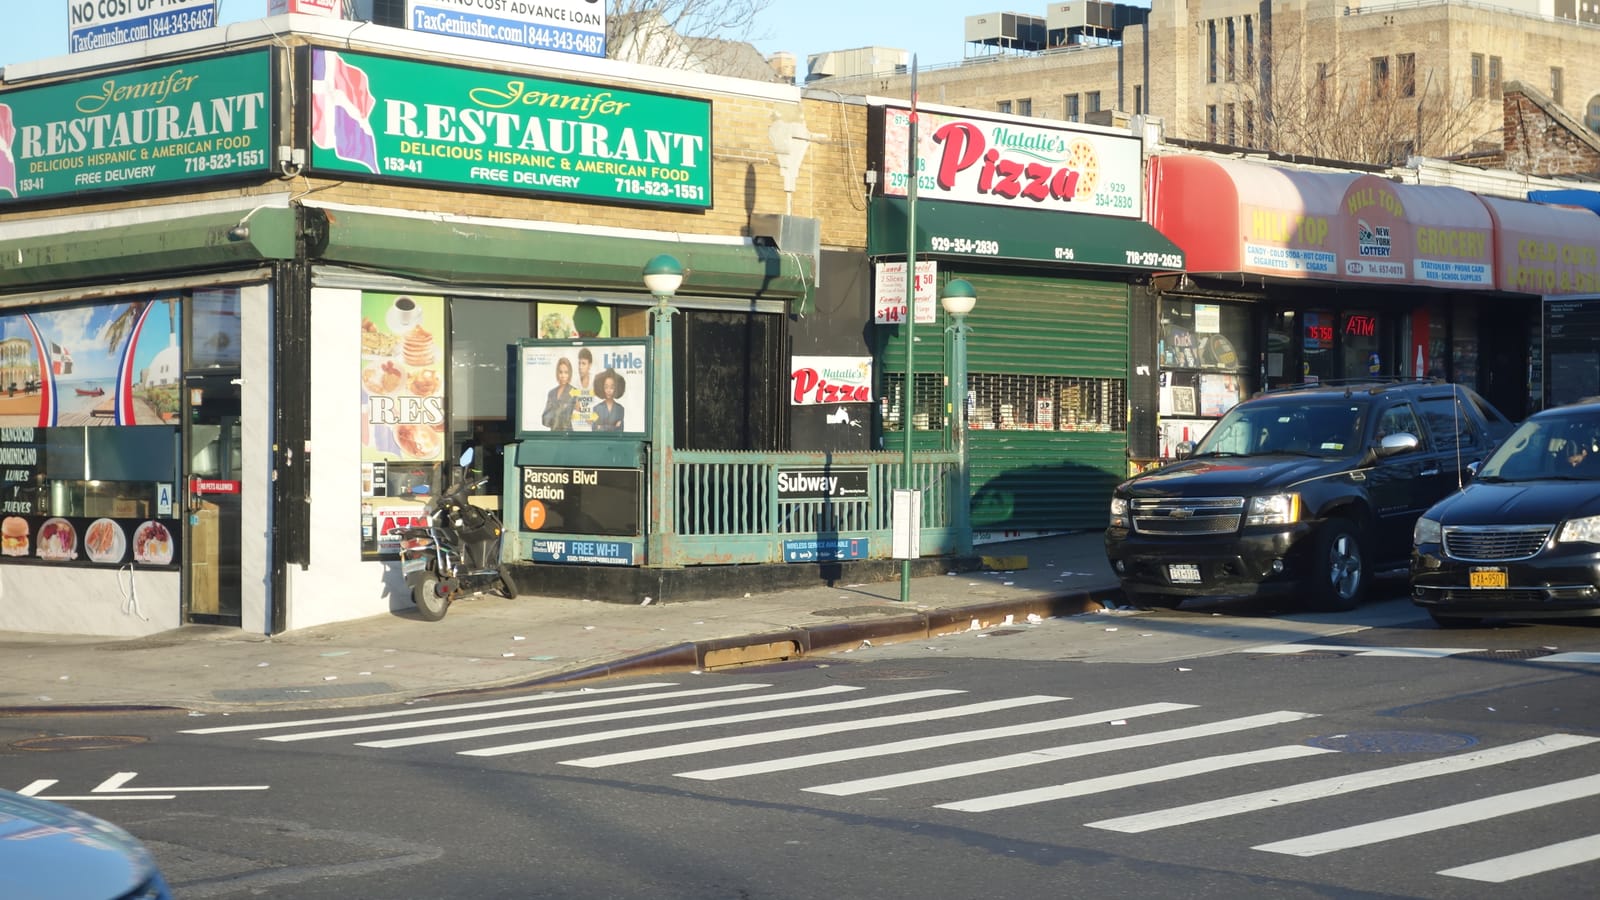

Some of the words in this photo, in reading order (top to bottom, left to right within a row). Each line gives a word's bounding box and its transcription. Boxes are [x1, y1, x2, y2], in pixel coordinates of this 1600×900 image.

[72, 4, 94, 24] NO
[98, 0, 132, 19] COST
[477, 0, 507, 11] COST
[511, 2, 566, 20] ADVANCE
[569, 10, 601, 26] LOAN
[73, 25, 149, 52] TaxGeniusInc.com
[153, 9, 213, 37] 844-343-6487
[415, 9, 523, 43] TaxGeniusInc.com
[529, 27, 603, 54] 844-343-6487
[75, 69, 199, 113] Jennifer
[468, 80, 631, 120] Jennifer
[20, 92, 264, 160] RESTAURANT
[895, 115, 911, 126] 87-5
[384, 99, 703, 168] RESTAURANT
[992, 127, 1065, 152] Natalie's
[30, 156, 84, 173] DELICIOUS
[88, 149, 137, 166] HISPANIC
[140, 148, 149, 160] &
[152, 139, 212, 158] AMERICAN
[216, 135, 251, 150] FOOD
[185, 149, 264, 173] 718-523-1551
[400, 141, 483, 160] DELICIOUS
[488, 150, 555, 168] HISPANIC
[560, 158, 571, 170] &
[575, 160, 647, 178] AMERICAN
[651, 167, 689, 182] FOOD
[932, 121, 1080, 202] Pizza
[383, 157, 423, 173] 153-41
[20, 177, 44, 191] 153-41
[75, 172, 102, 185] FREE
[105, 165, 156, 182] DELIVERY
[470, 166, 509, 182] FREE
[513, 170, 581, 188] DELIVERY
[615, 178, 704, 200] 718-523-1551
[1110, 182, 1126, 193] 929
[1095, 193, 1133, 209] 354-2830
[1348, 187, 1376, 216] HILL
[1379, 189, 1403, 217] TOP
[1252, 210, 1290, 242] HILL
[1295, 215, 1328, 246] TOP
[1375, 227, 1390, 237] NEW
[931, 236, 999, 255] 929-354-2830
[1360, 246, 1390, 256] LOTTERY
[1375, 238, 1391, 246] YORK
[1417, 227, 1486, 257] GROCERY
[1054, 247, 1074, 260] 87-56
[1126, 250, 1182, 268] 718-297-2625
[1247, 245, 1266, 255] CANDY
[1270, 249, 1285, 258] COLD
[1285, 250, 1301, 259] SODA
[1303, 251, 1314, 260] HOT
[1314, 252, 1334, 262] COFFEE
[1518, 239, 1557, 263] COLD
[1562, 244, 1598, 268] CUTS
[1253, 256, 1288, 268] CIGARETTES
[1305, 262, 1328, 271] CIGARS
[1507, 265, 1556, 289] LOTTO
[877, 305, 908, 322] $14.0
[1345, 315, 1376, 337] ATM
[603, 352, 642, 369] Little
[823, 368, 862, 379] Natalie's
[791, 367, 870, 404] Pizza
[368, 395, 444, 425] RES
[0, 447, 37, 466] DOMINICANO
[5, 469, 30, 482] LUNES
[524, 468, 569, 485] Parsons
[572, 469, 598, 485] Blvd
[777, 472, 838, 495] Subway
[13, 485, 20, 497] Y
[160, 487, 169, 506] A
[524, 484, 564, 500] Station
[2, 501, 31, 513] JUEVES
[529, 506, 540, 524] F
[572, 542, 594, 556] FREE
[596, 543, 619, 557] WI-FI
[786, 542, 807, 550] WIRELESS
[807, 541, 825, 549] SERVICE
[826, 540, 849, 548] AVAILABLE
